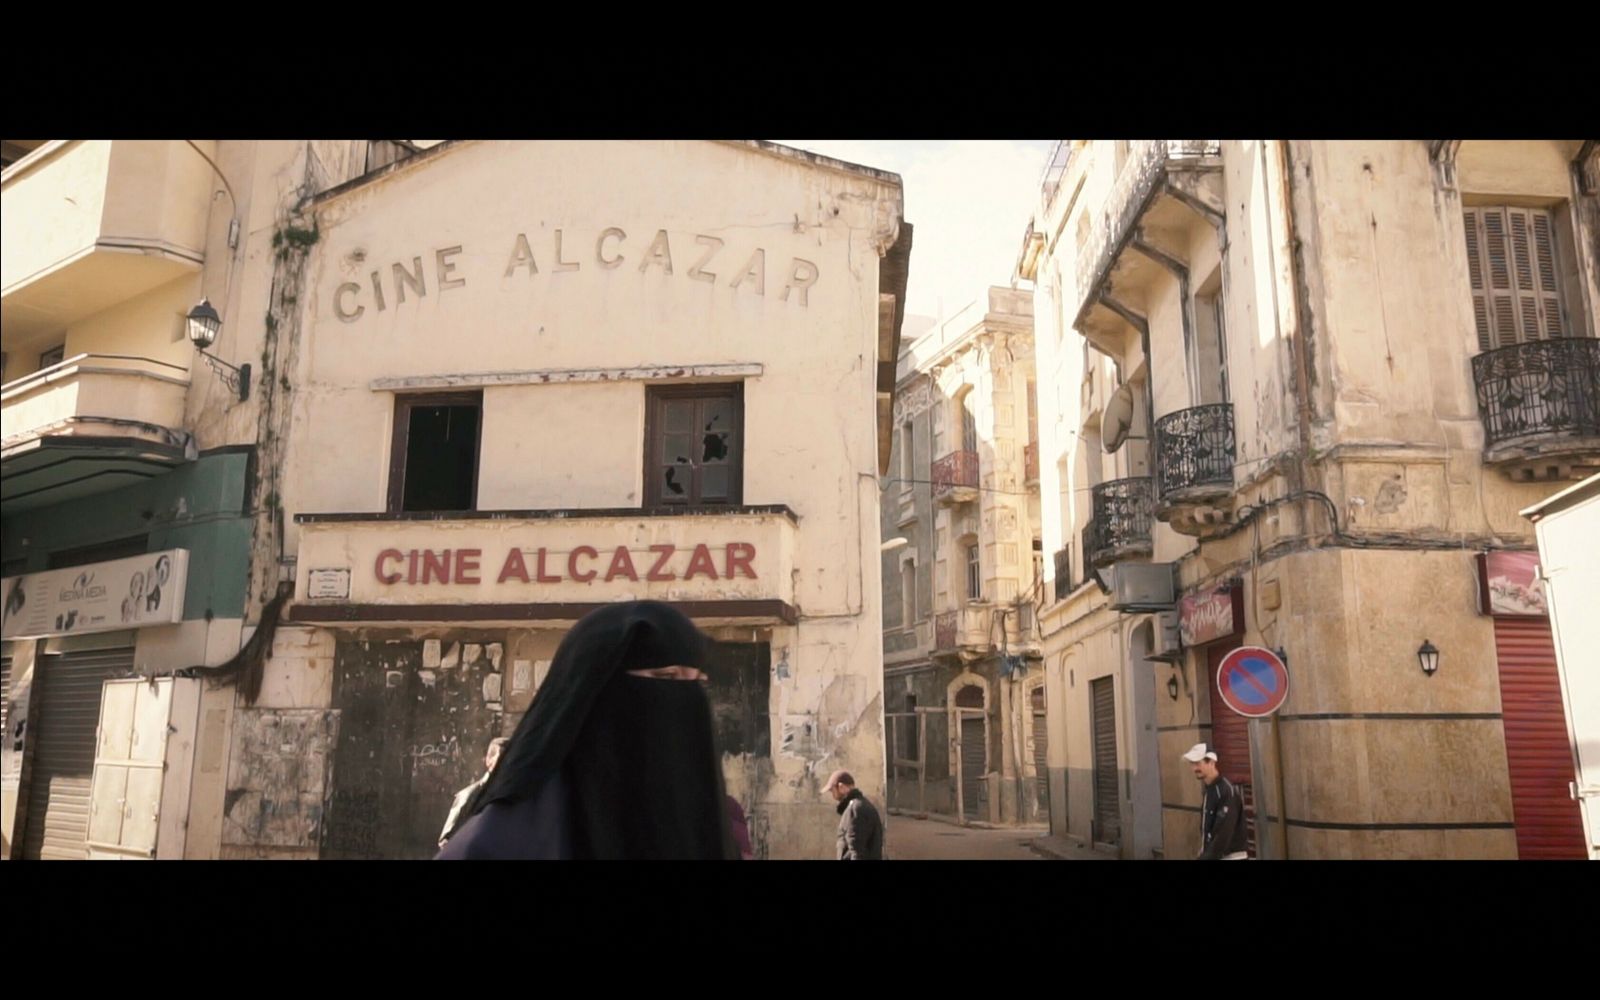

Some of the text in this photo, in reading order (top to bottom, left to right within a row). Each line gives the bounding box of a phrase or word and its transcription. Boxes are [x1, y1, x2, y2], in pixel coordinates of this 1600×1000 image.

[333, 227, 819, 324] CINE ALCAZAR
[374, 548, 482, 585] CINE
[497, 542, 758, 583] ALCAZAR
